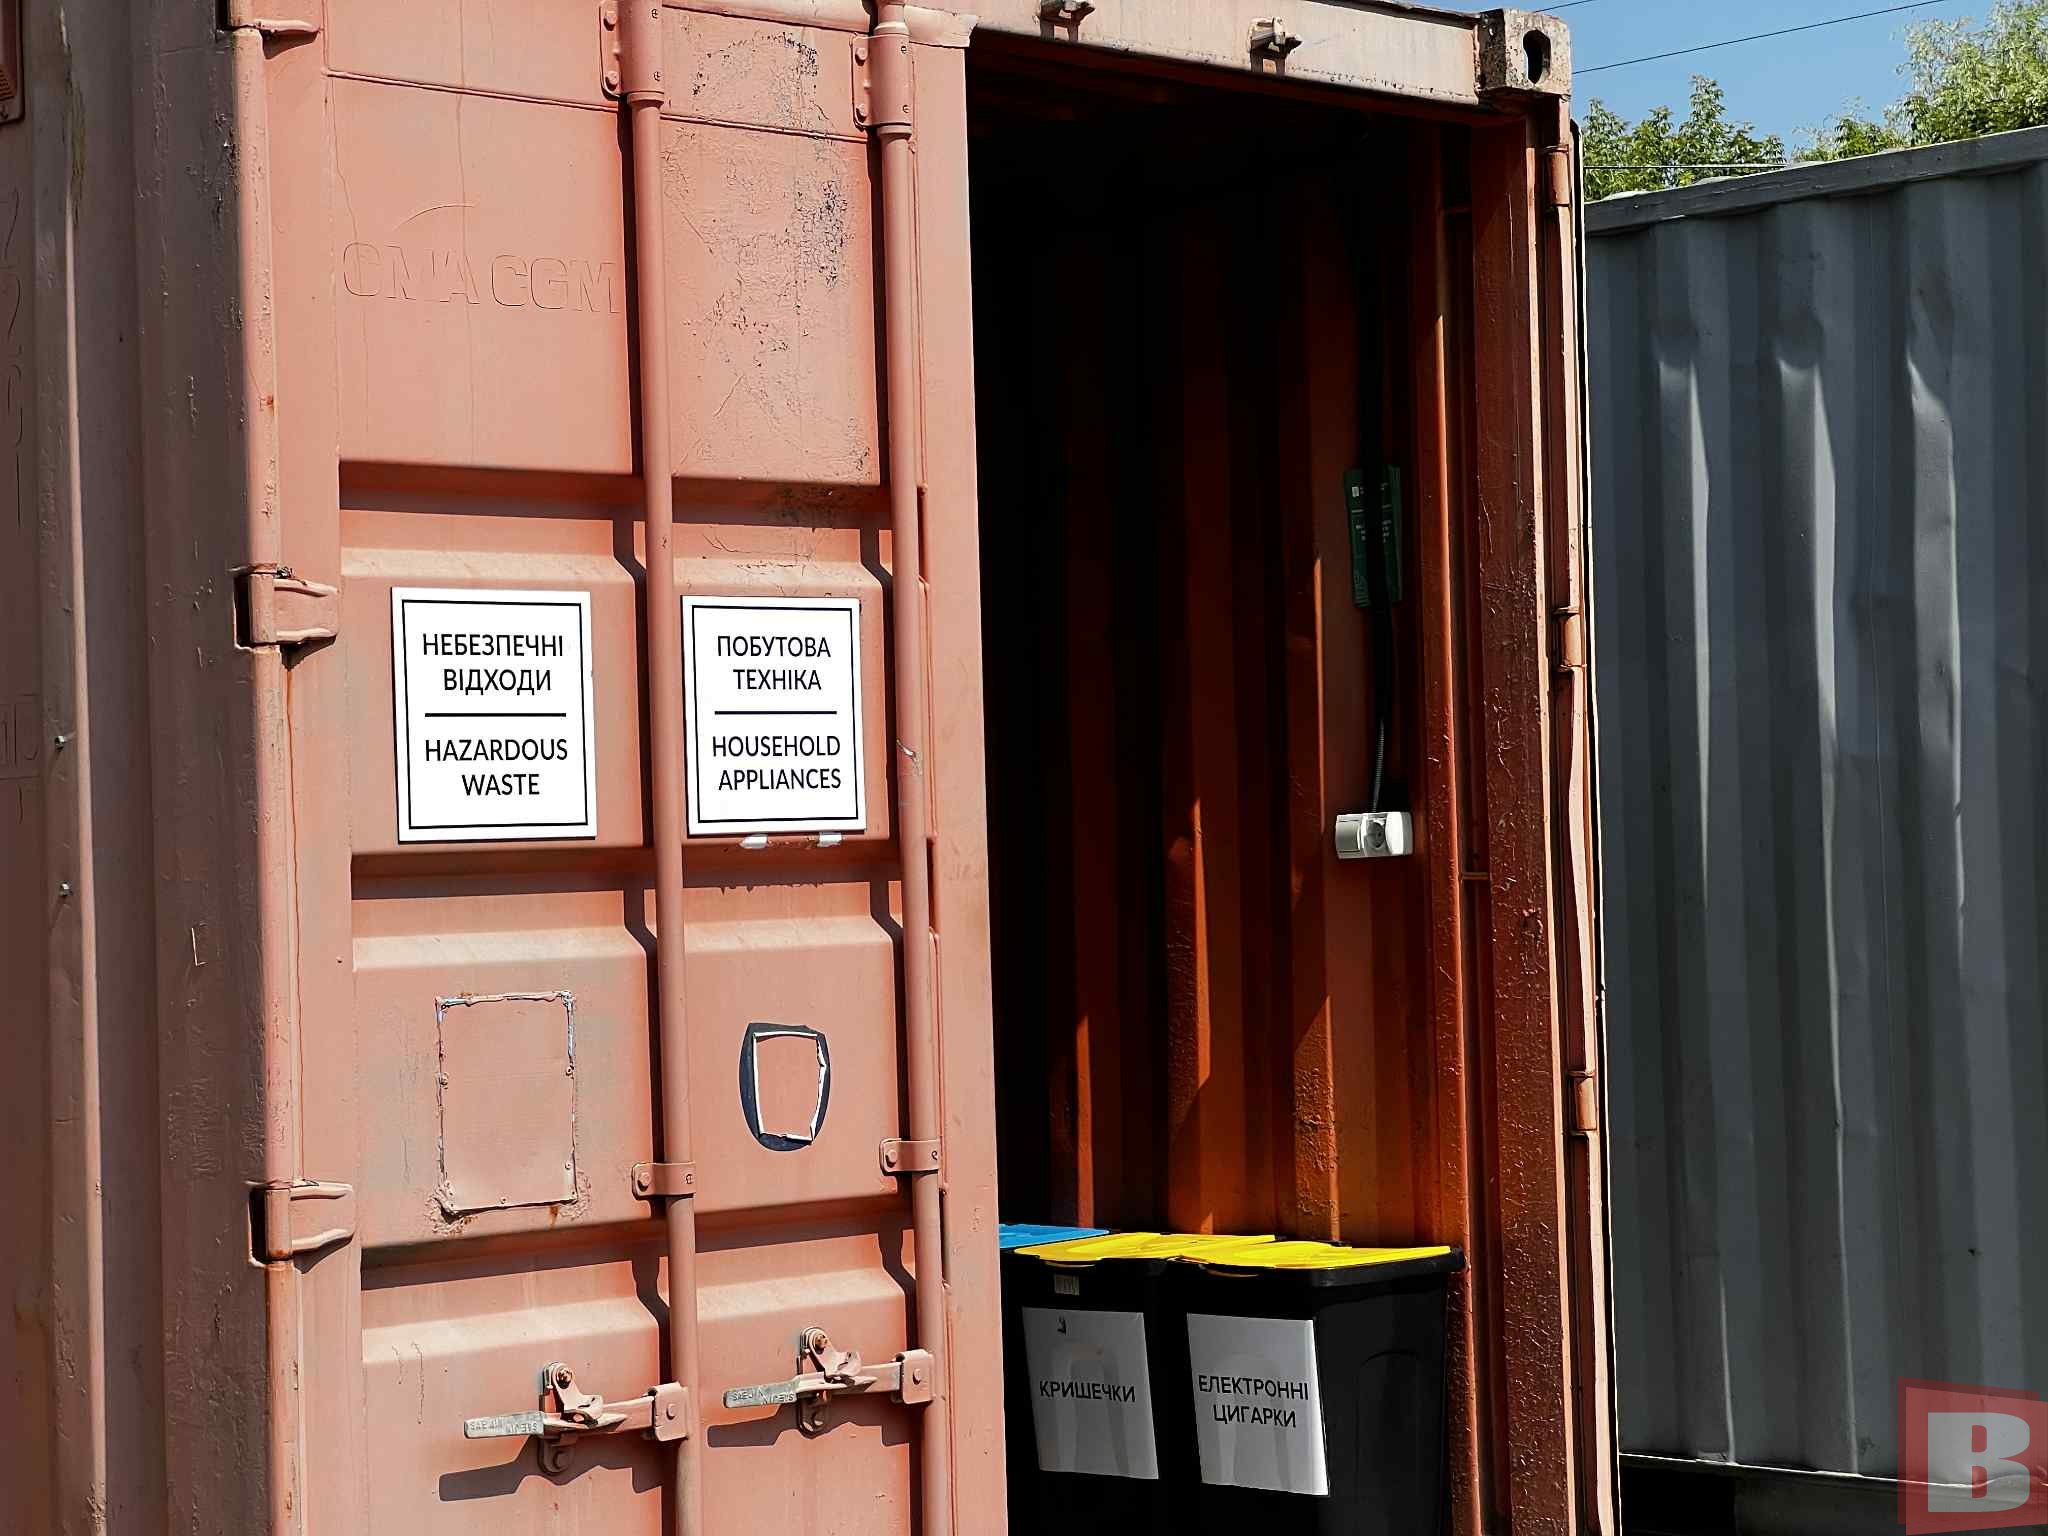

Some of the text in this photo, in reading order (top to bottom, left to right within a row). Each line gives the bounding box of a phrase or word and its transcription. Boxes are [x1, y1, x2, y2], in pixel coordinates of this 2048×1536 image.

[422, 633, 563, 657] НЕБЕЗПЕЧНІ
[717, 636, 832, 658] ПОБУТОВА
[444, 669, 551, 696] ВІДХОДИ
[733, 669, 822, 691] ТЕХНІКА
[425, 739, 568, 762] HAZARDOUS
[712, 736, 841, 757] HOUSEHOLD
[462, 774, 540, 796] WASTE
[718, 769, 841, 791] APPLIANCES
[1039, 1380, 1136, 1403] КРИШЕЧКИ
[1198, 1375, 1309, 1402] ЕЛЕКТРОННІ
[1212, 1404, 1297, 1429] ЦИГАРКИ
